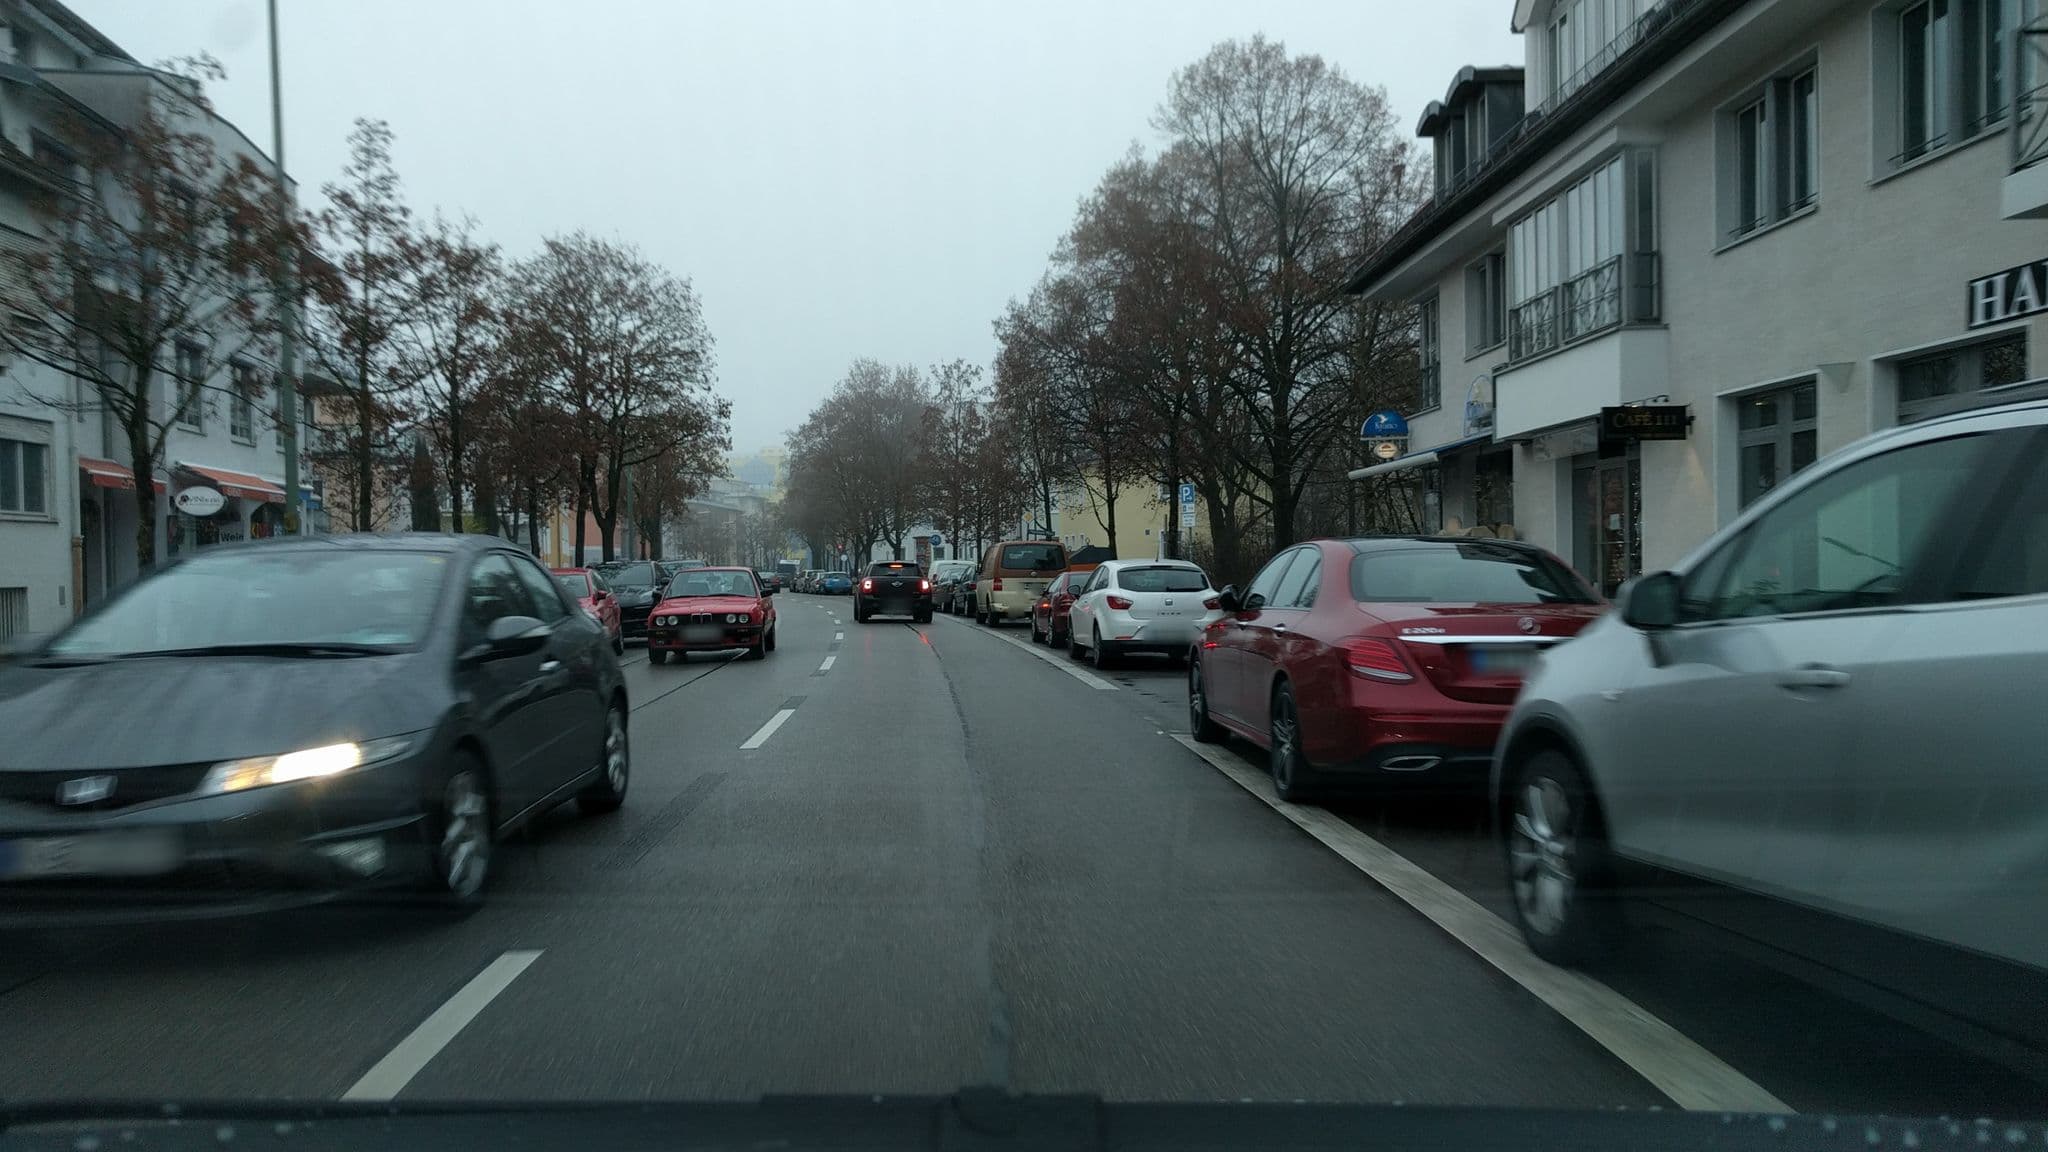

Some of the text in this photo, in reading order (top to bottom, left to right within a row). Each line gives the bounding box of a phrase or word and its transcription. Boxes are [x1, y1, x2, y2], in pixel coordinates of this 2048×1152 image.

[1970, 261, 2048, 326] HA
[1182, 487, 1191, 502] P
[221, 532, 244, 542] Wein
